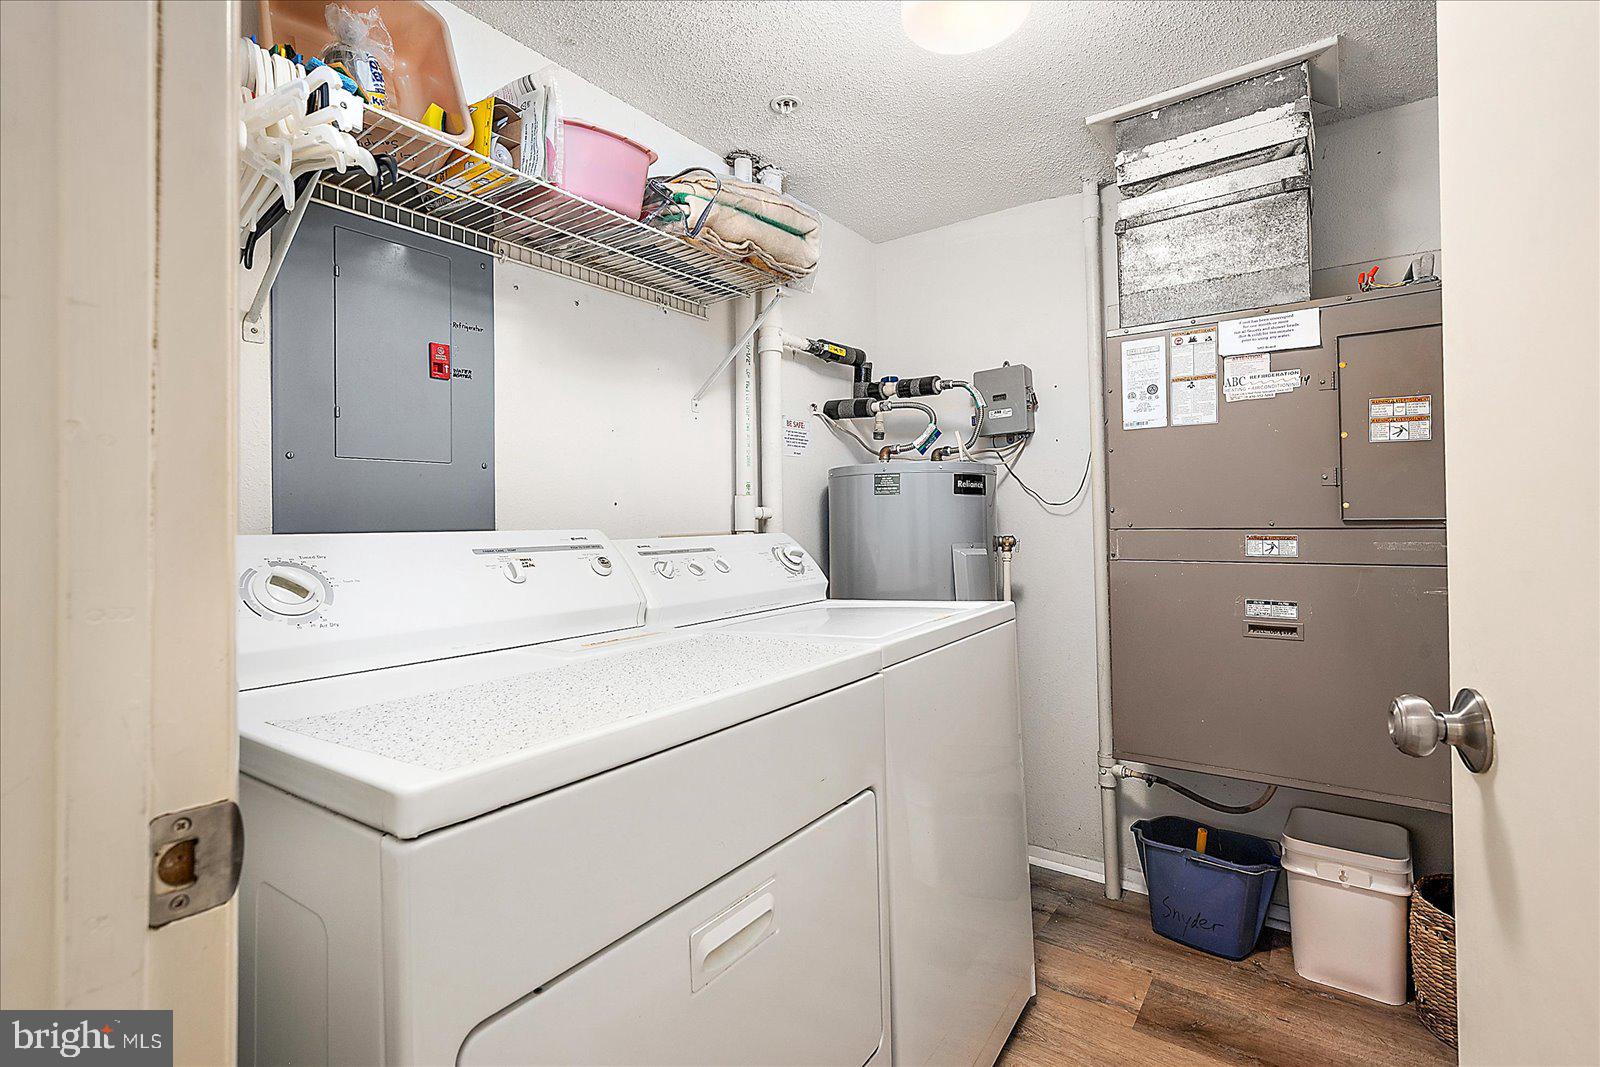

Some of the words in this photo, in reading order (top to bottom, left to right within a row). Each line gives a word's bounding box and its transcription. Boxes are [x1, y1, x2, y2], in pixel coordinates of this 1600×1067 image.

[1250, 370, 1299, 380] REFRIGERATION
[1225, 376, 1246, 388] ABC
[957, 480, 984, 488] Reliance
[1162, 896, 1224, 936] Snyder
